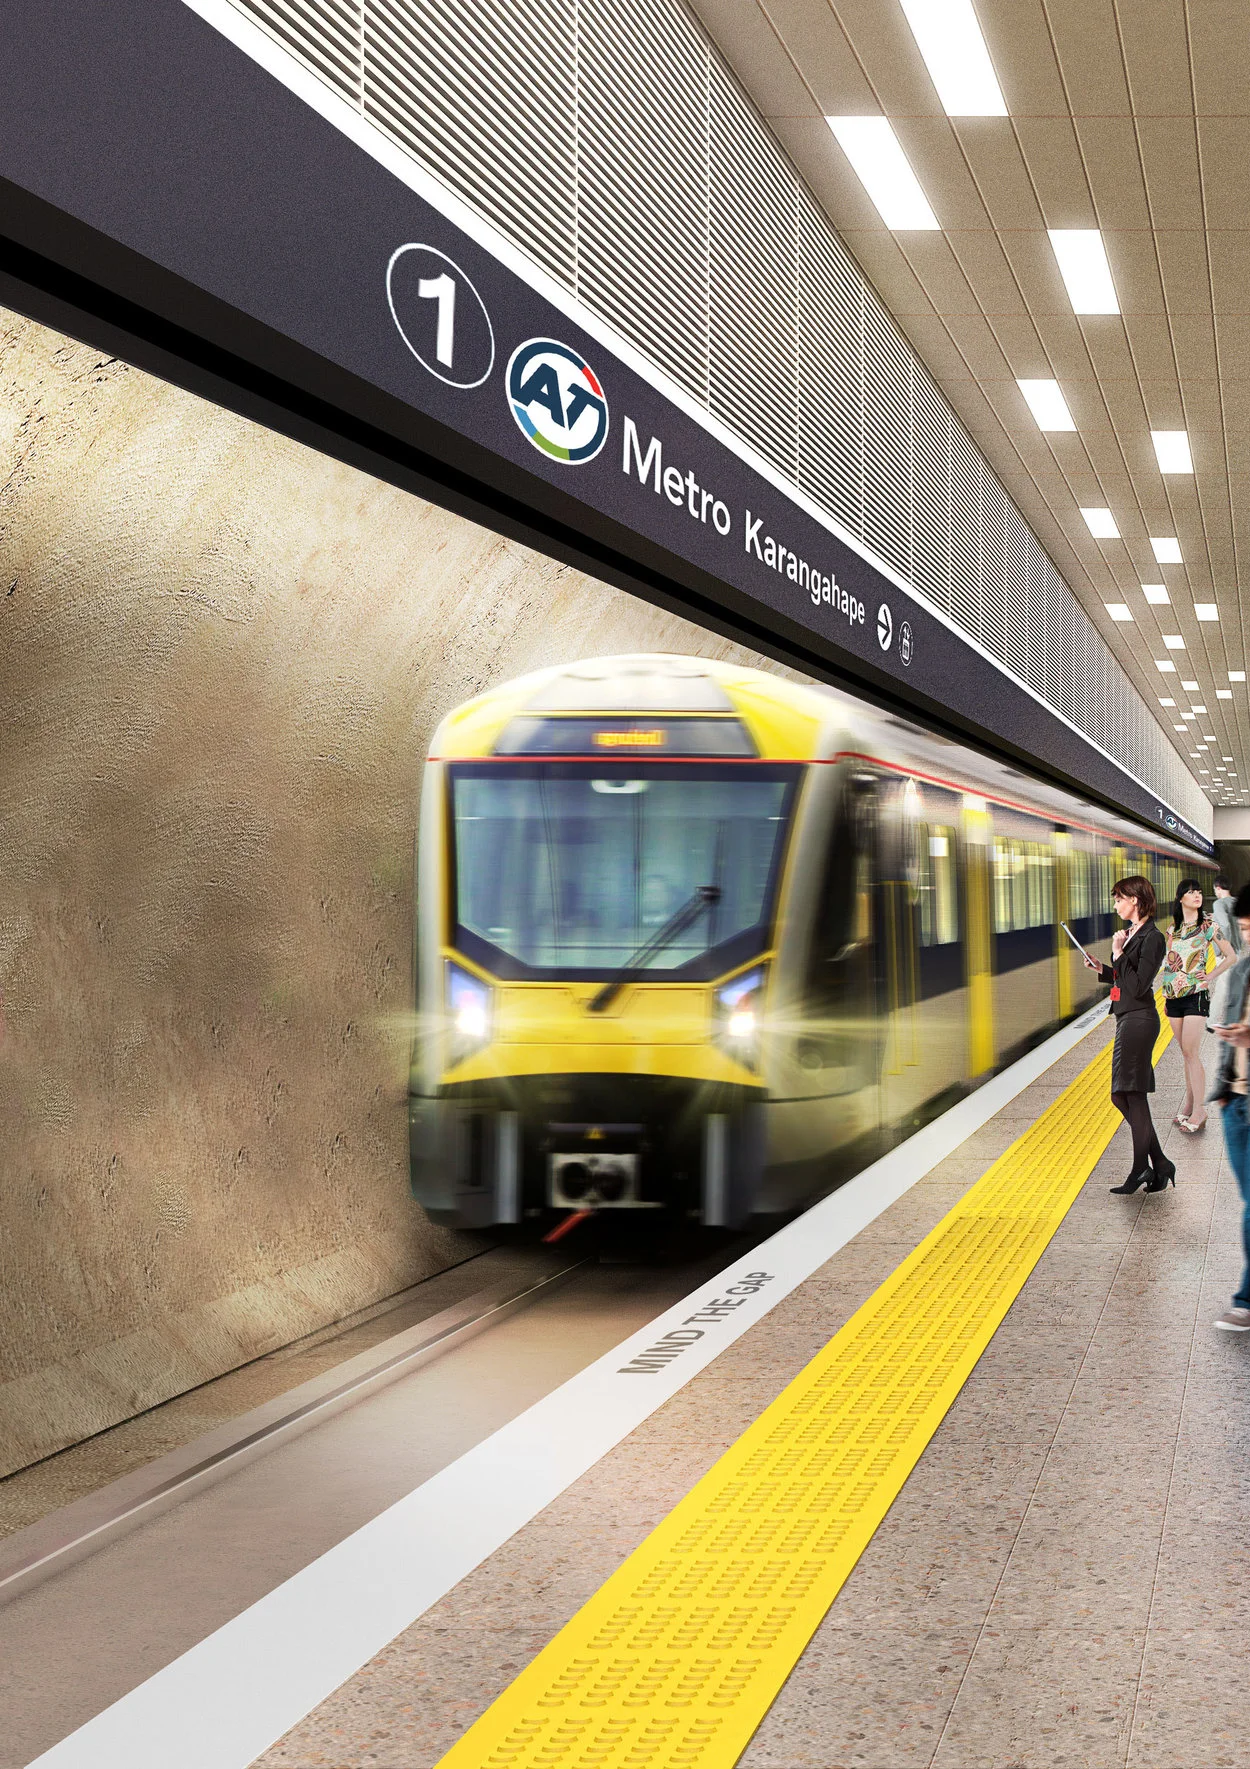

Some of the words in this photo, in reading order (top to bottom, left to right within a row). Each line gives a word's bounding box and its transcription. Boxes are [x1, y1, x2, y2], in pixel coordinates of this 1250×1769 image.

[418, 272, 456, 369] 1
[622, 416, 732, 536] Metro
[744, 509, 866, 626] Karangahape
[616, 1329, 705, 1374] MIND
[681, 1298, 747, 1323] THE
[725, 1271, 776, 1295] GAP
